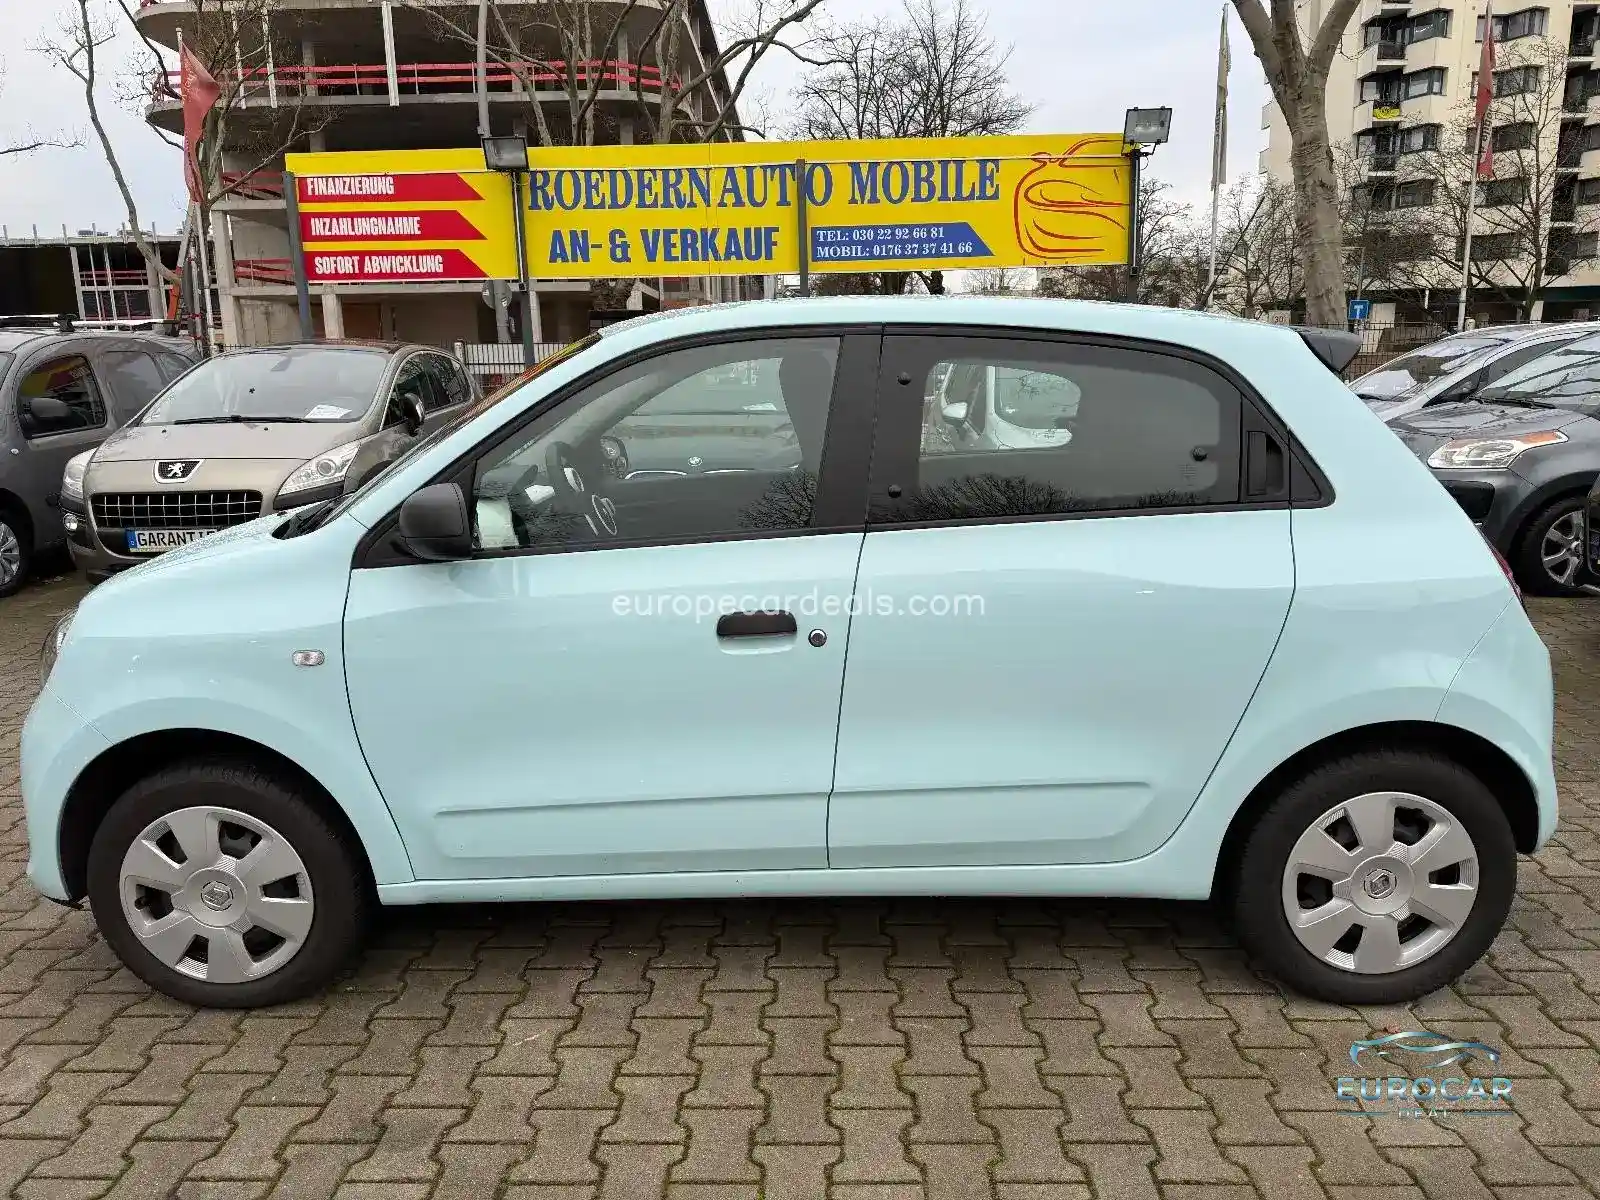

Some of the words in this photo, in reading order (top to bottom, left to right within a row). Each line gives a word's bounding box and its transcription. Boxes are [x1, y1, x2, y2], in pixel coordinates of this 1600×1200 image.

[306, 177, 394, 195] FINANZIERUNG
[848, 159, 1000, 204] MOBILE
[311, 217, 421, 236] INZAHLUNGNAHME
[816, 231, 849, 242] TEL:
[853, 229, 874, 241] 030
[877, 229, 892, 240] 22
[895, 228, 909, 239] 92
[913, 228, 927, 238] 66
[930, 227, 945, 238] 81
[549, 230, 603, 263] AN-
[609, 229, 631, 263] &
[640, 227, 779, 262] VERKAUF
[816, 245, 869, 258] MOBIL:
[873, 244, 901, 256] 0176
[904, 244, 919, 255] 37
[922, 243, 937, 255] 37
[940, 243, 955, 254] 41
[957, 242, 973, 253] 66
[315, 256, 359, 274] SOFORT
[364, 255, 443, 273] ABWICKLUNG
[137, 531, 216, 546] GARANT
